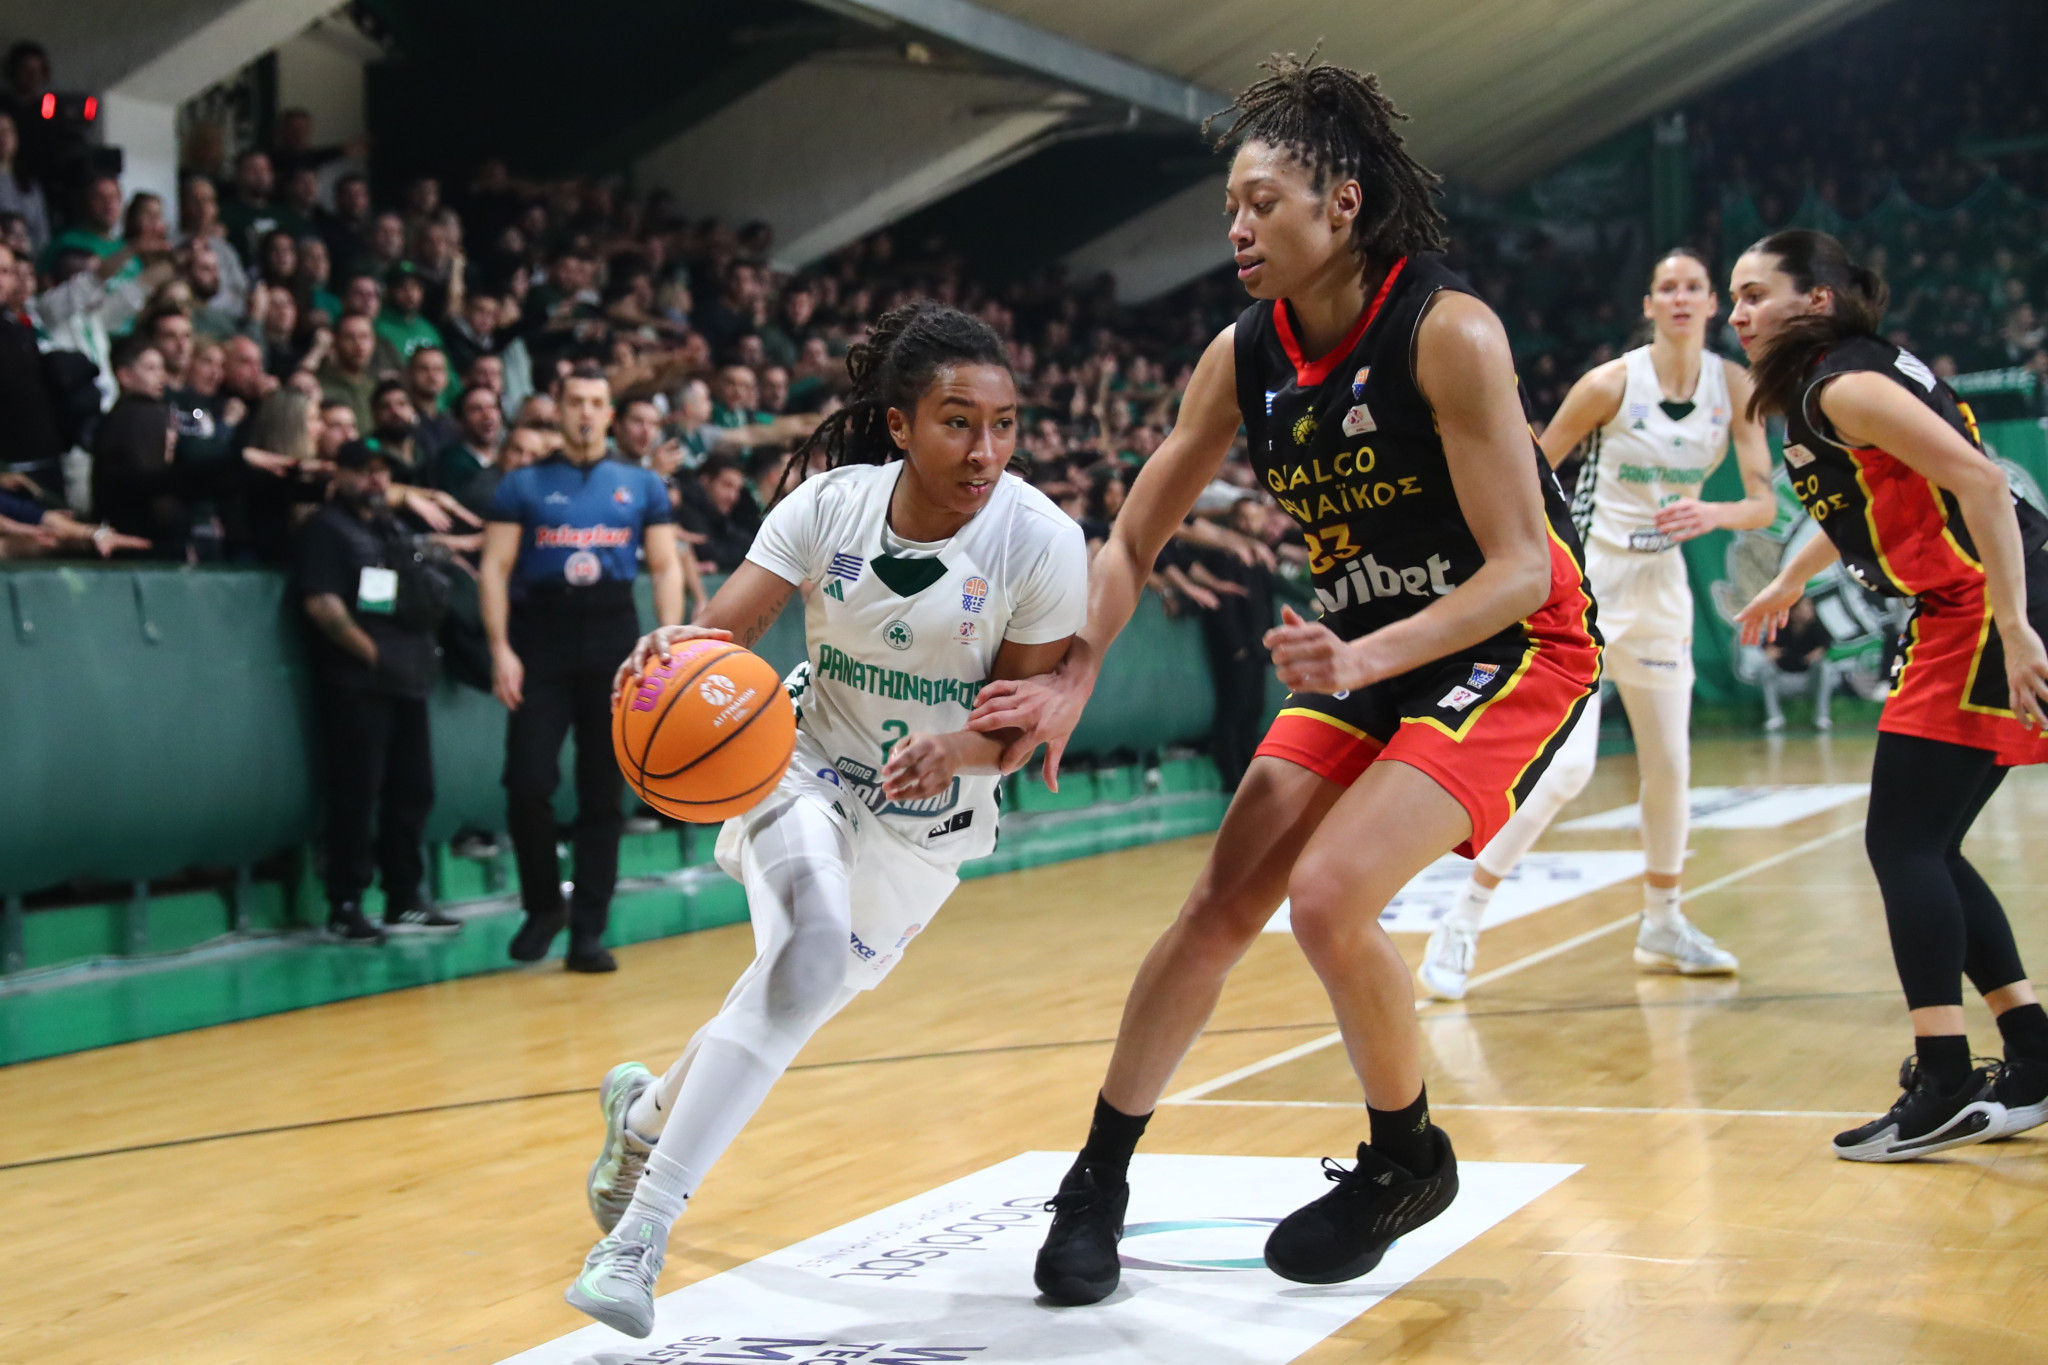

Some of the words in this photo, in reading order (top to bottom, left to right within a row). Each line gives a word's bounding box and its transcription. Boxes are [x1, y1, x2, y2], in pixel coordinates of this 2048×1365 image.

[1277, 476, 1423, 523] ΝΑΪΚΟΣ
[1314, 553, 1456, 613] vibet
[881, 719, 909, 766] 2
